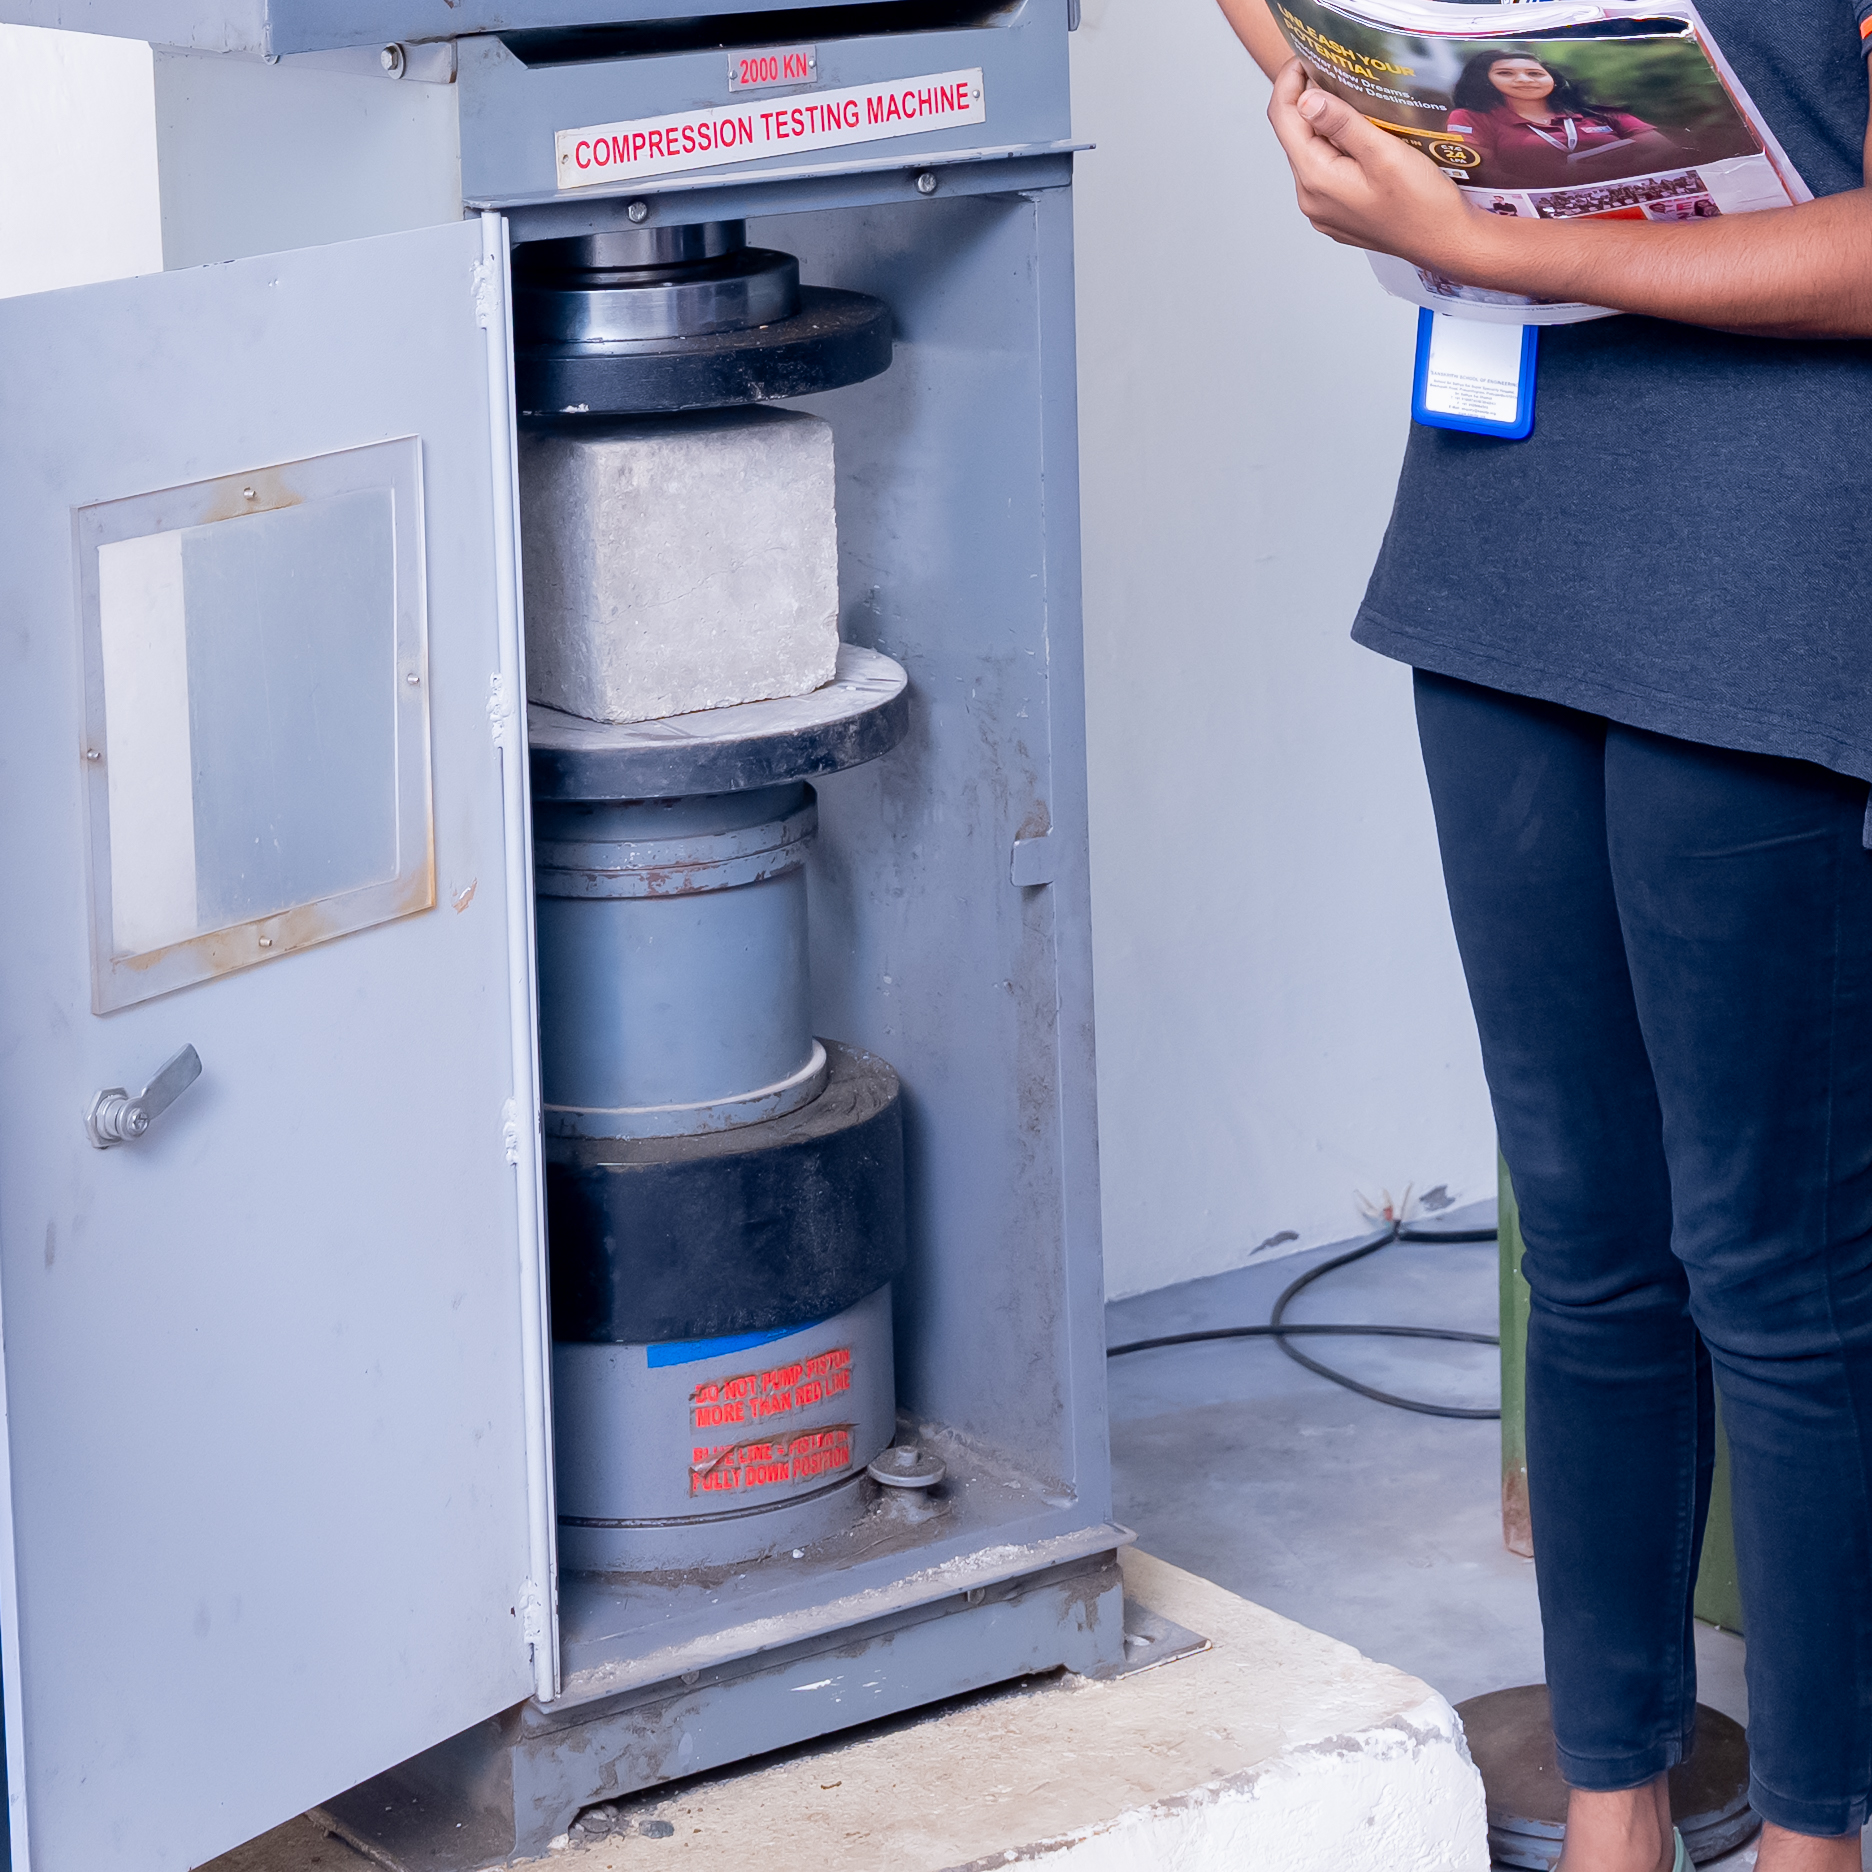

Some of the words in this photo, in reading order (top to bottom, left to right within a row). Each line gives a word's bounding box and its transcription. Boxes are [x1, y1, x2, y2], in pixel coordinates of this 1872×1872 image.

[1284, 18, 1380, 81] POTENTIAL
[1356, 53, 1415, 76] YOUR
[740, 58, 779, 84] 2000
[783, 52, 808, 78] KN
[1334, 67, 1358, 83] New
[1361, 80, 1414, 99] Dreams,
[1339, 77, 1363, 92] New
[1366, 88, 1447, 111] Destinations
[574, 115, 754, 170] COMPRESSION
[760, 99, 860, 141] TESTING
[867, 81, 970, 125] MACHINE
[696, 1401, 744, 1427] MORE
[749, 1392, 791, 1417] THAN
[796, 1380, 821, 1406] RED
[826, 1369, 850, 1396] LINE
[724, 1376, 756, 1400] NOT
[762, 1364, 802, 1392] PUMP
[746, 1463, 789, 1486] DOWN
